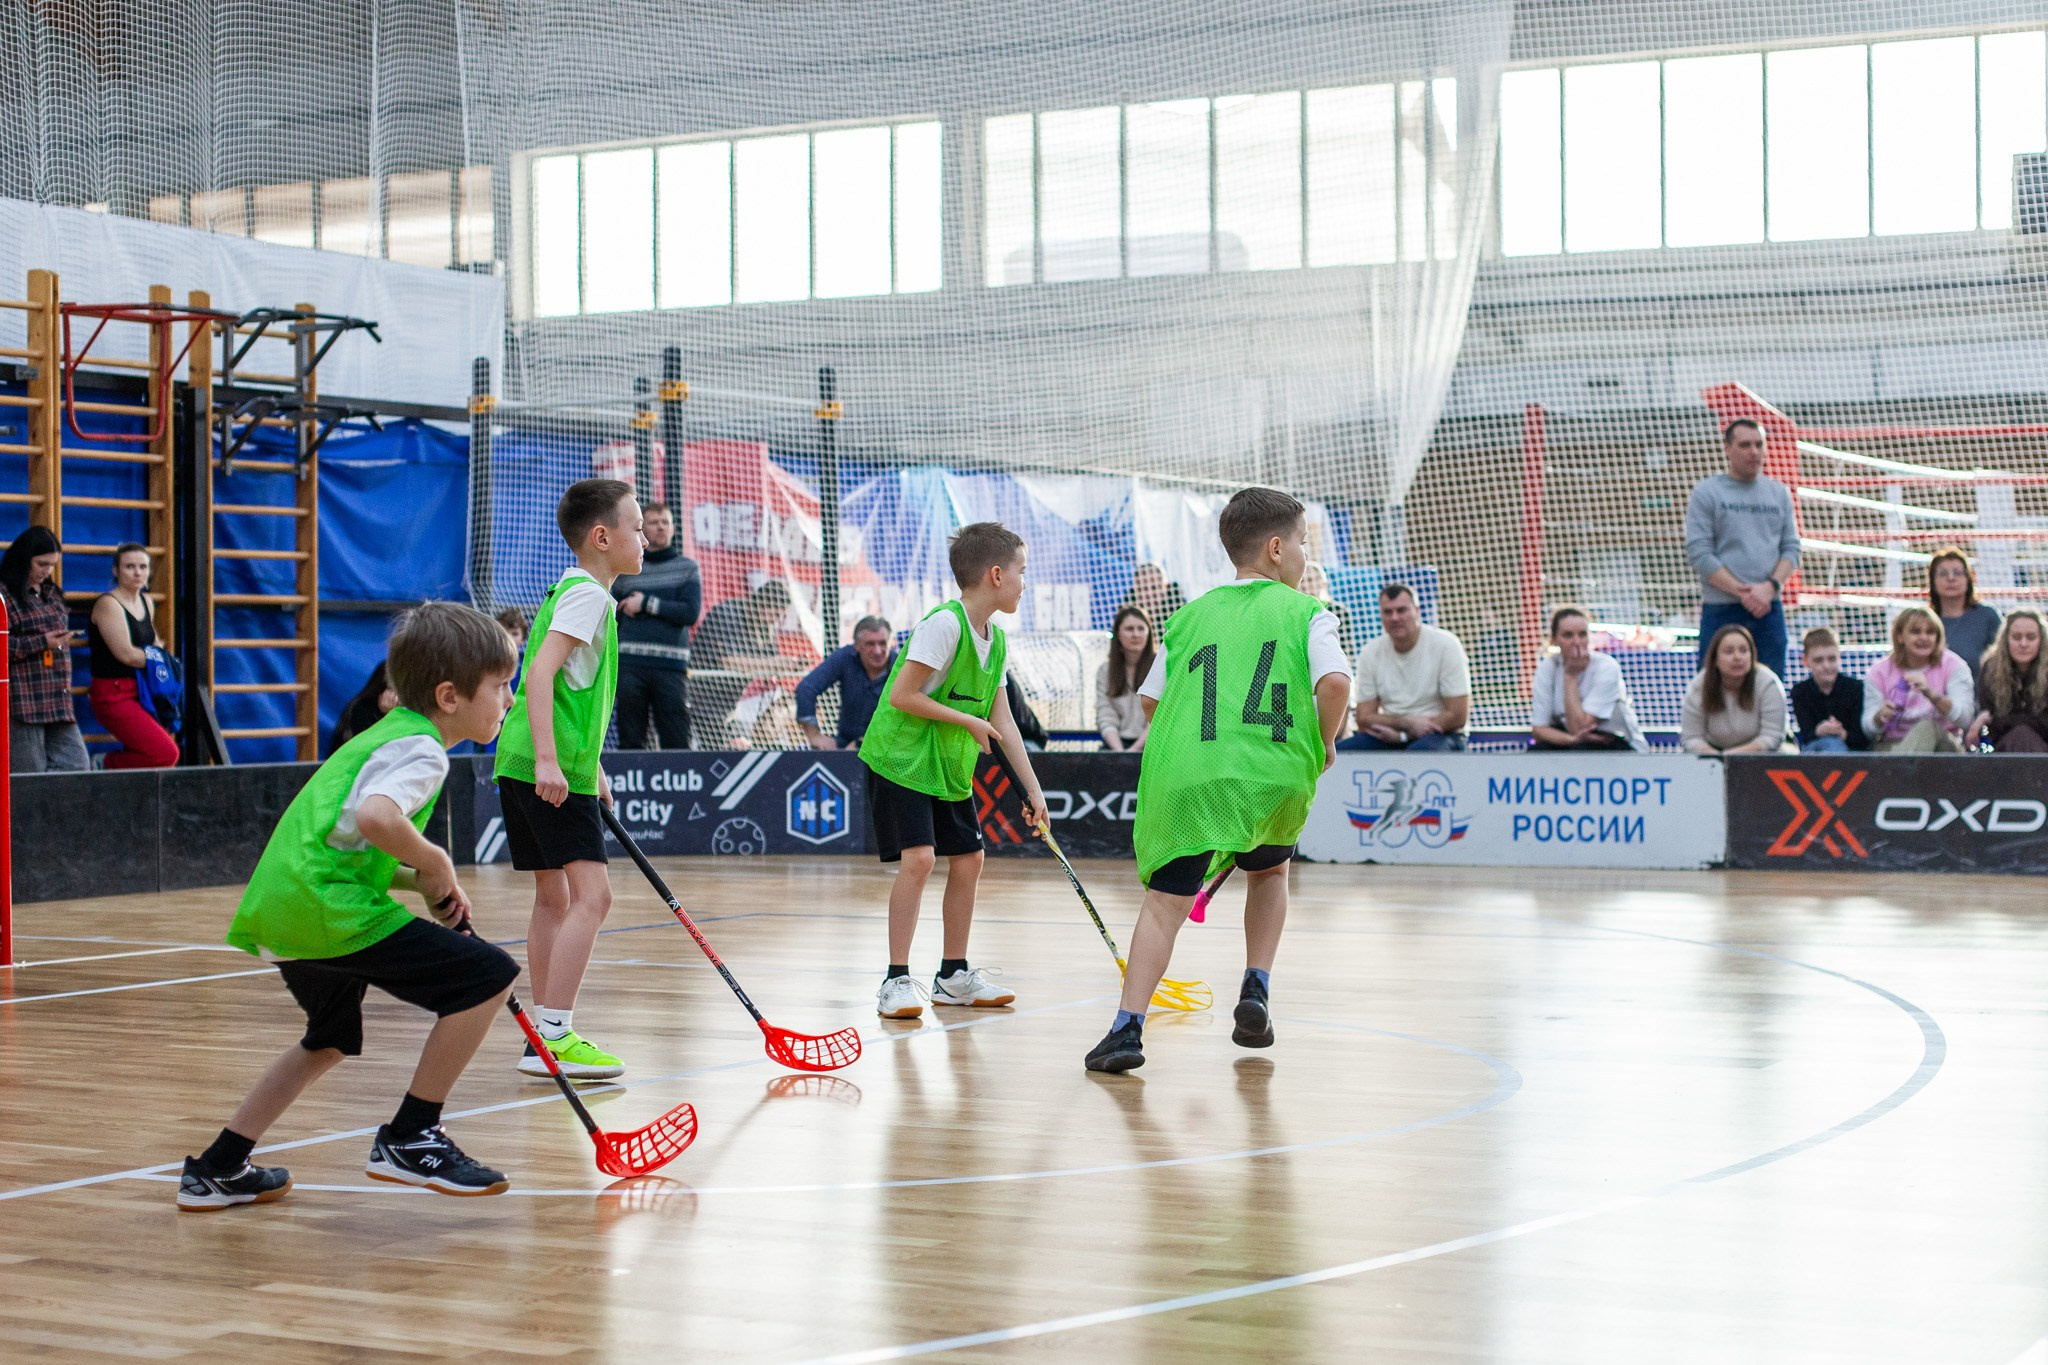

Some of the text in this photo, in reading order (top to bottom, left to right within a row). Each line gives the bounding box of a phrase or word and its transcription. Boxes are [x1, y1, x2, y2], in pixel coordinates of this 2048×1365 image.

[1188, 640, 1294, 743] 14
[650, 769, 703, 792] club
[1488, 777, 1672, 806] МИНСПОРТ
[626, 799, 674, 826] City
[1874, 798, 2047, 832] OXD
[1512, 814, 1645, 843] РОССИИ
